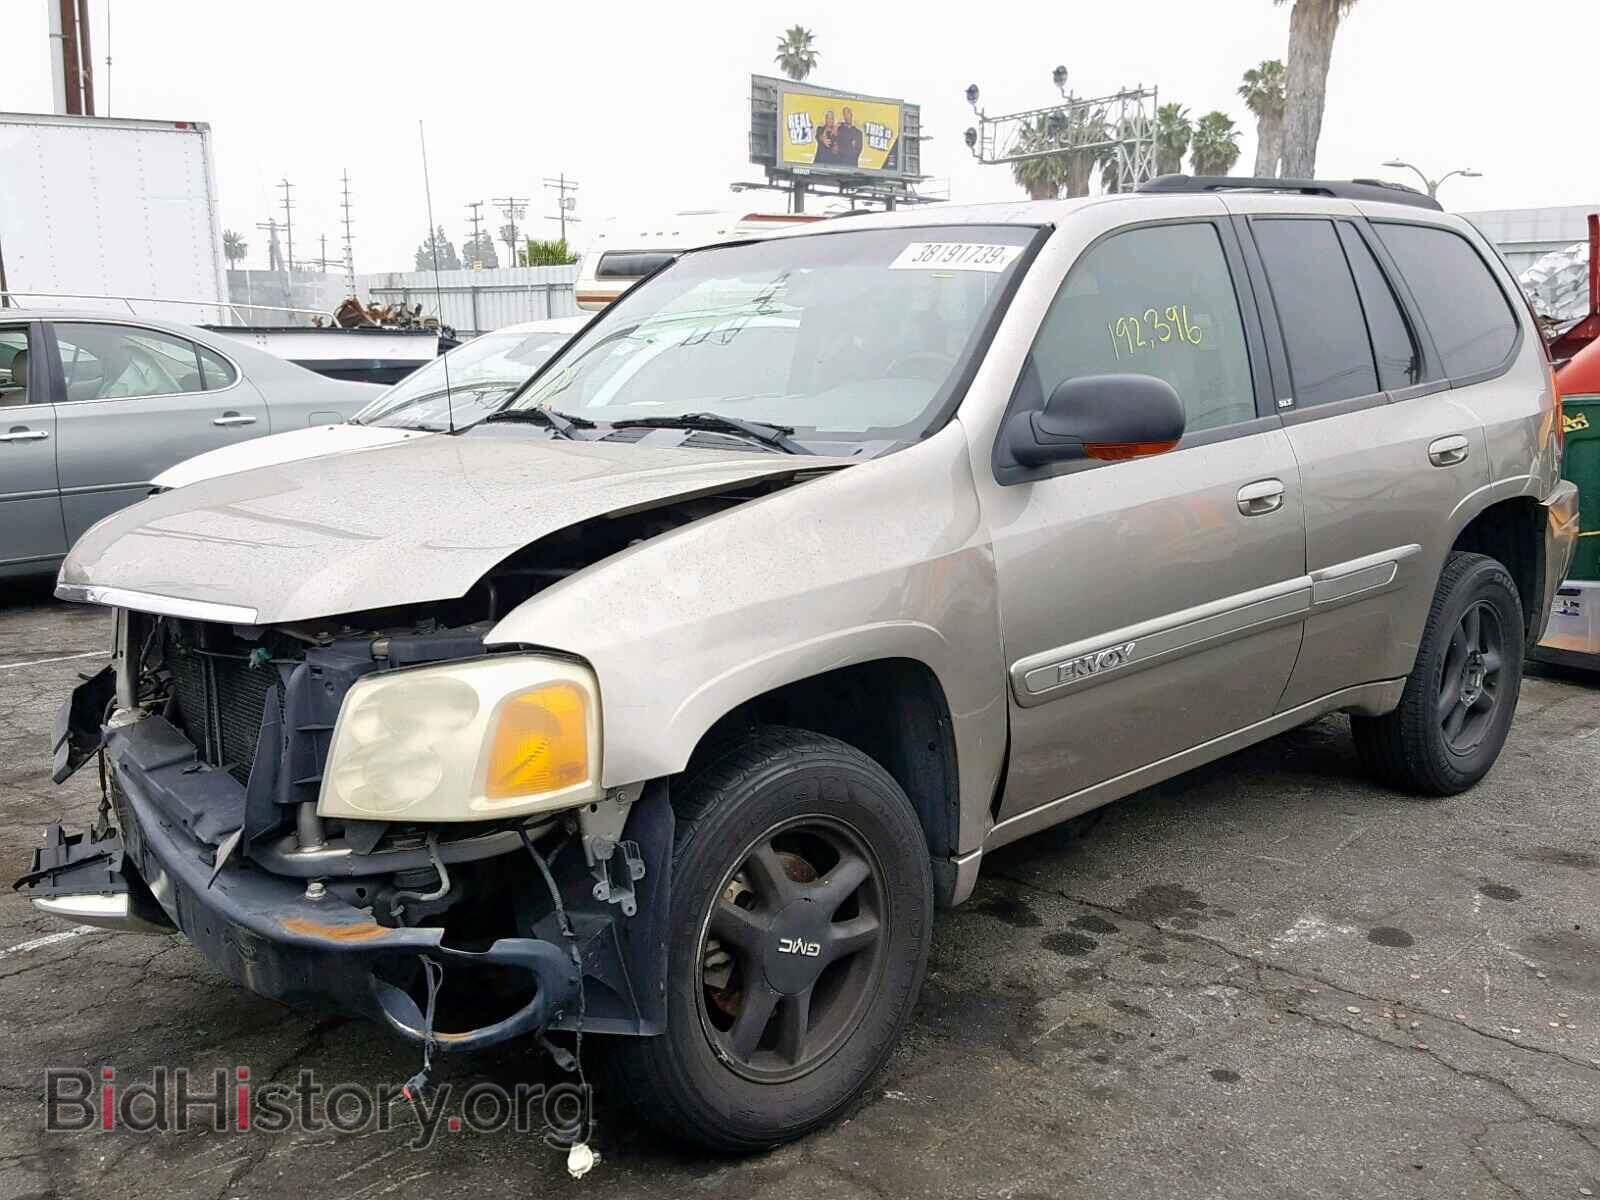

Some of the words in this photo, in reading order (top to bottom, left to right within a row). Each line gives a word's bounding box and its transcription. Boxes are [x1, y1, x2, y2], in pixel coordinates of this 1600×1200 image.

[1107, 304, 1202, 360] 192,396
[1057, 643, 1135, 682] ENVOY
[778, 938, 820, 957] GMC
